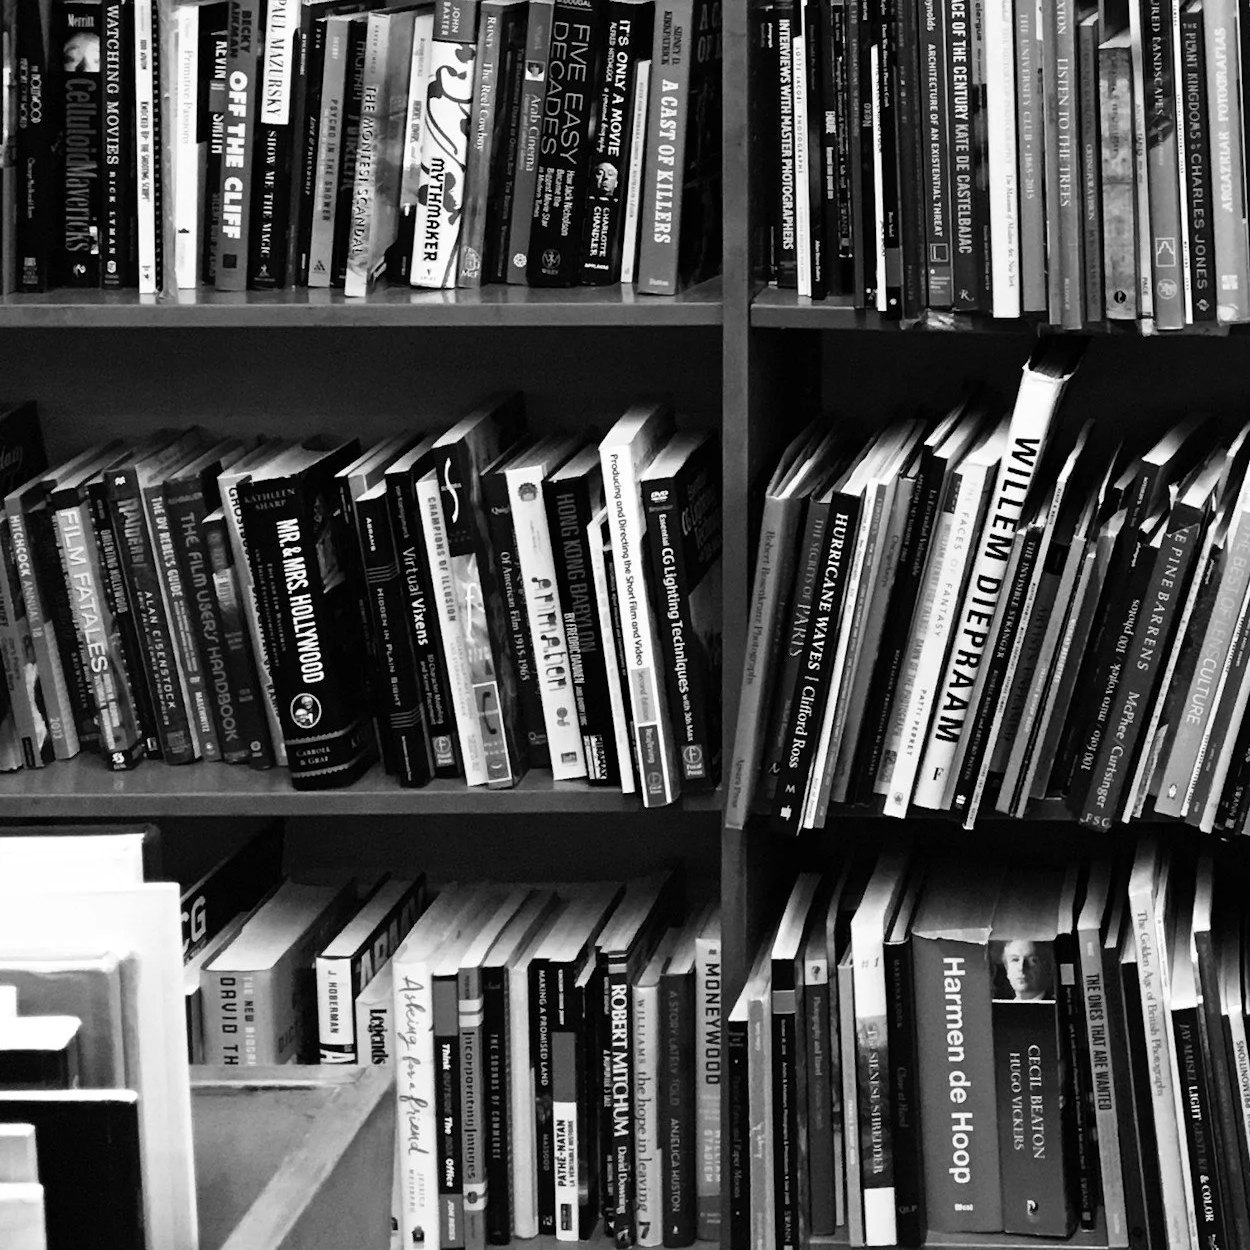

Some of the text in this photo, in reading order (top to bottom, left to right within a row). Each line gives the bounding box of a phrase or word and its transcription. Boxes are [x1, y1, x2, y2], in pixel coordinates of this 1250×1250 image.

[106, 5, 119, 165] WATCHING MOVIES
[440, 2, 461, 36] JOHN BAXTER
[608, 20, 630, 157] IT'S ONLY A MOVIE
[952, 22, 966, 36] OF
[952, 40, 966, 63] THE
[222, 70, 248, 239] OFF THE CLIFF
[653, 79, 678, 243] A CAST OF KILLERS
[953, 67, 968, 120] CENTURY
[424, 158, 445, 261] MYTHMAKER
[60, 509, 108, 673] FILM FATALES
[276, 518, 325, 684] MR. & MRS. HOLLYWOOD
[402, 547, 430, 645] Virtual Vixens
[661, 548, 690, 693] CG Lighting Techniques
[807, 513, 849, 670] HURRICANE WAVES
[935, 436, 1041, 743] WILLEM DIEPRAAM
[612, 984, 629, 1137] ROBERT MITCHUM
[705, 963, 720, 1085] MONEYWOOD
[943, 957, 975, 1184] Harmen de Hoop
[1009, 1052, 1024, 1150] HUGO VICKERS
[1027, 1044, 1045, 1159] CECIL BEATON
